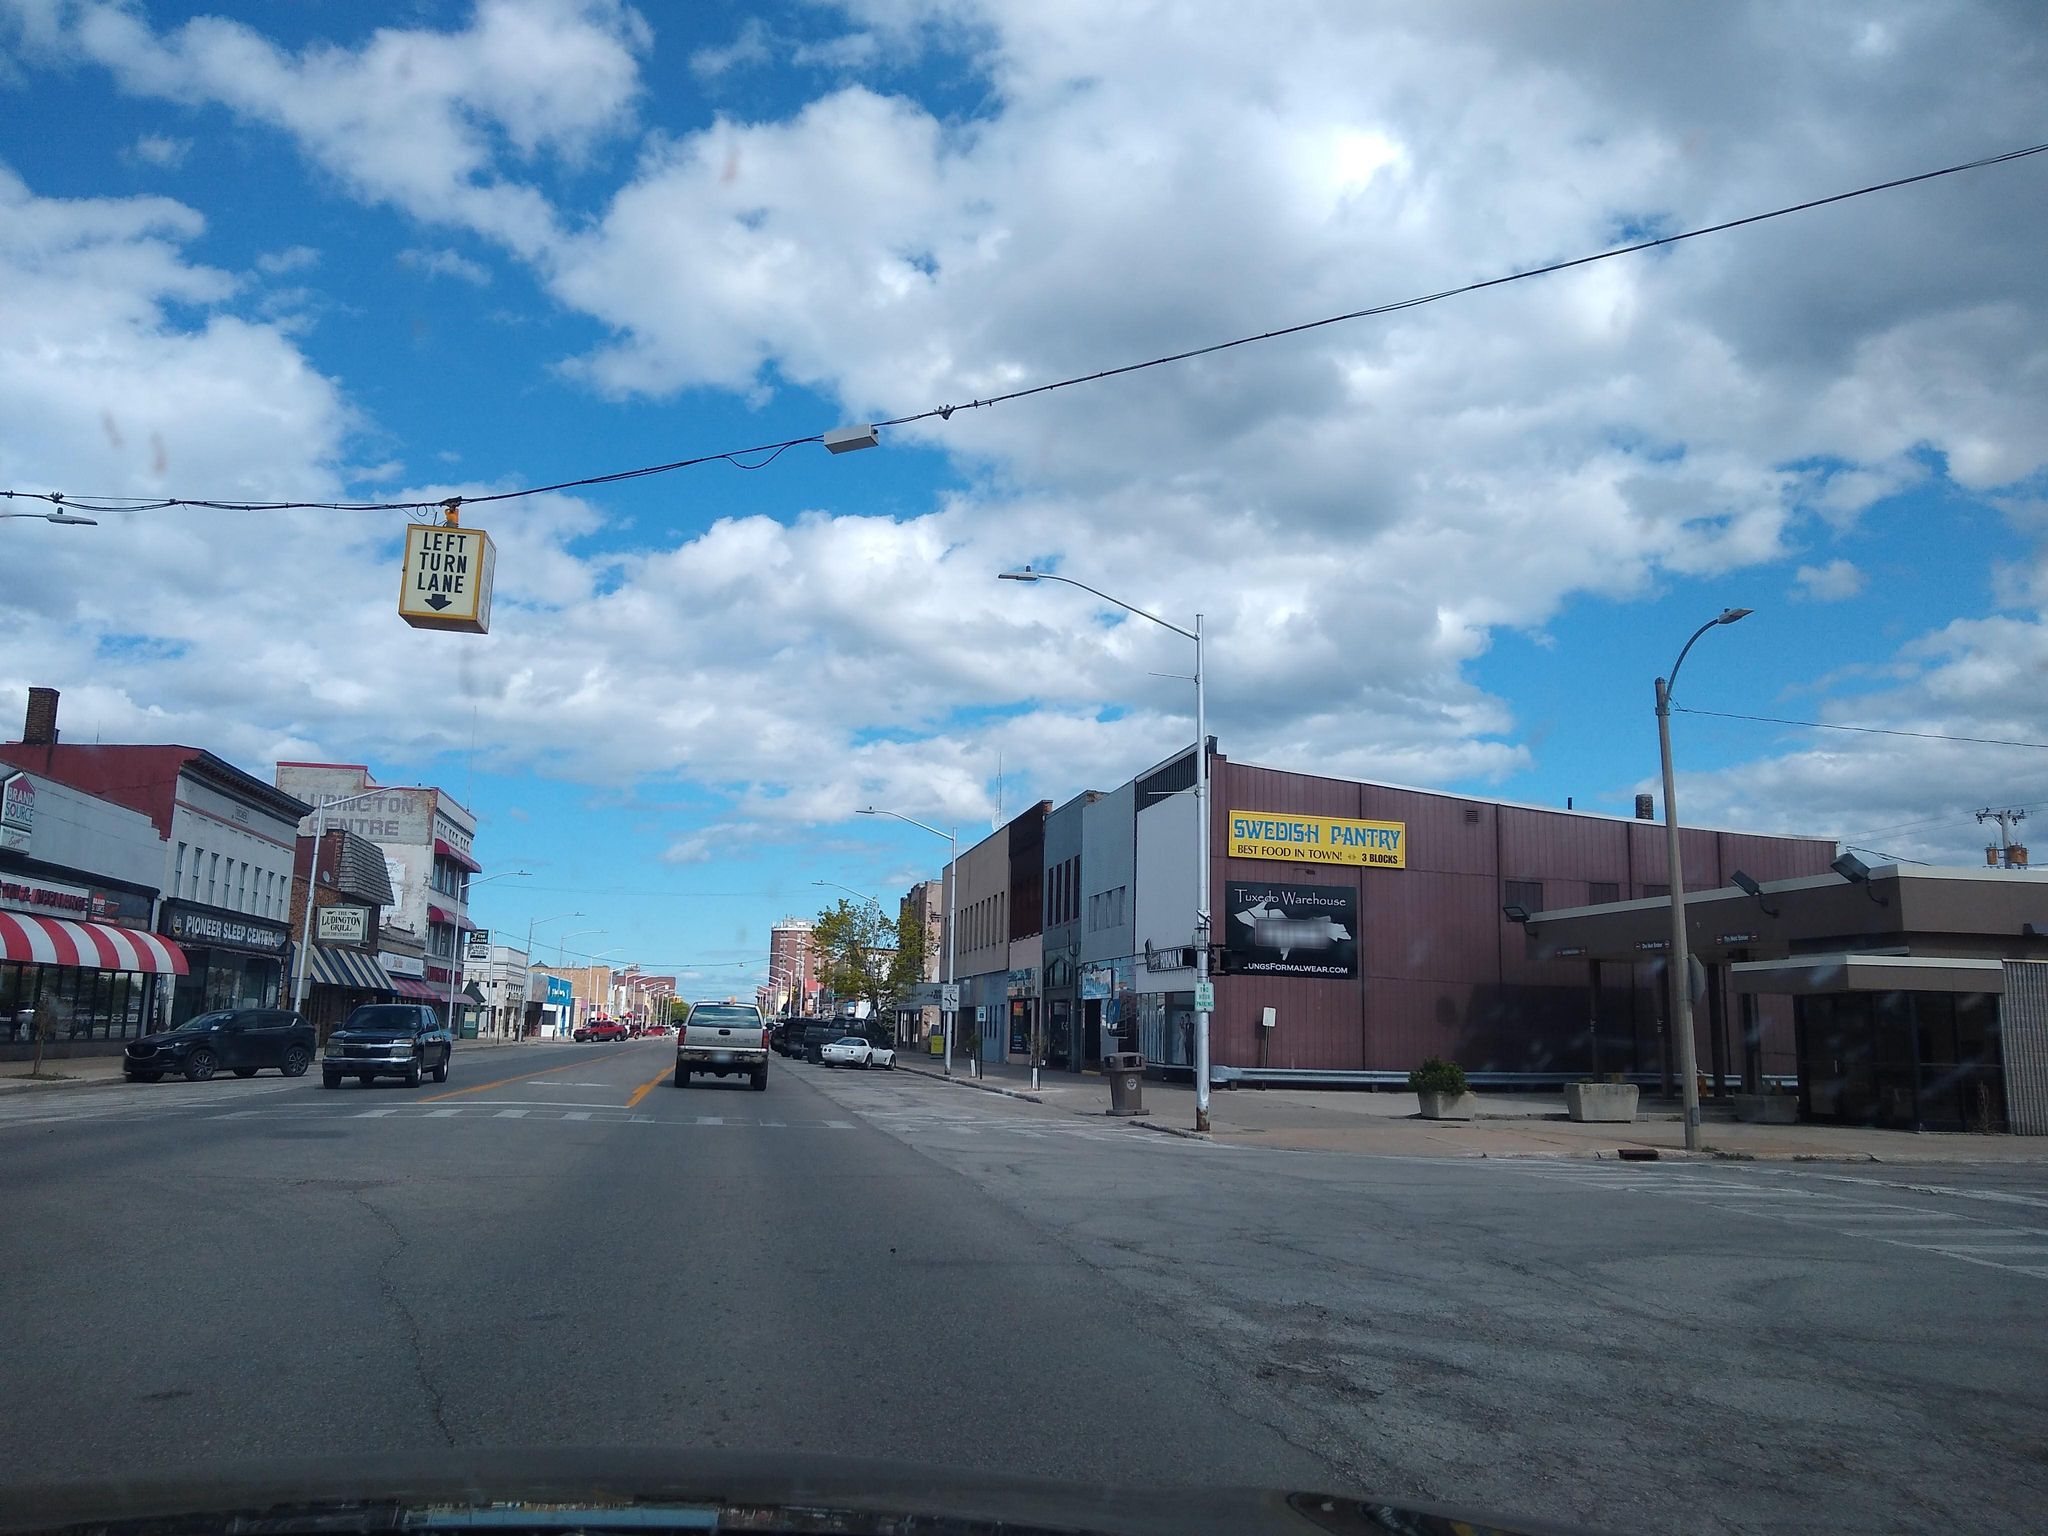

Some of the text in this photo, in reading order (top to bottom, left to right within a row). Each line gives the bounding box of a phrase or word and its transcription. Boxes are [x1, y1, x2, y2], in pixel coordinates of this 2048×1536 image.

[423, 532, 467, 553] LEFT
[419, 552, 468, 574] TURN
[417, 572, 464, 594] LANE
[7, 787, 35, 807] BRAND
[5, 801, 34, 823] SOURCE
[309, 817, 399, 836] CENTRE
[1233, 819, 1402, 850] SWEDISH PANTRY
[1237, 844, 1398, 864] BEST FOOD IN TOWN! 3 BLOCKS
[1234, 888, 1346, 906] Tuxedo Warehouse
[185, 915, 222, 938] PIONEER
[223, 922, 246, 941] SLEEP
[321, 915, 362, 928] LUDINGTON
[330, 924, 353, 932] GRILL
[1243, 962, 1348, 974] UNGSFORMALWEAR.COM
